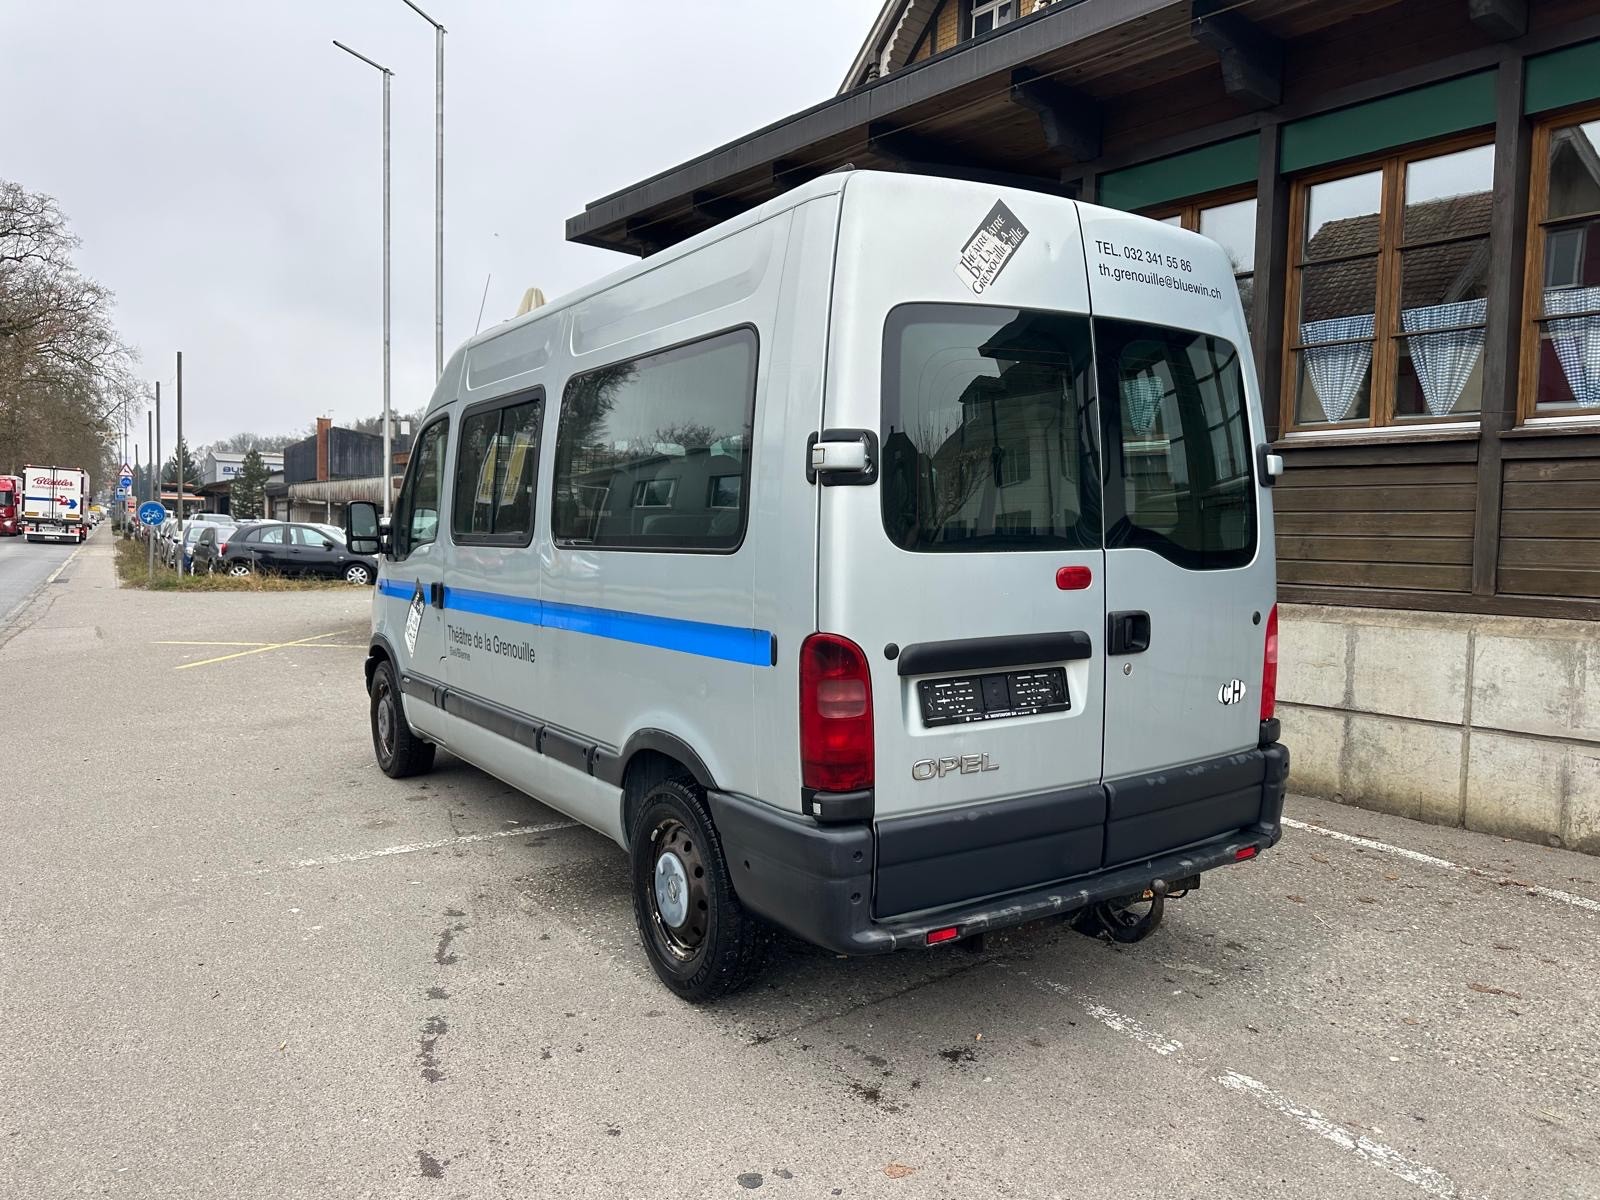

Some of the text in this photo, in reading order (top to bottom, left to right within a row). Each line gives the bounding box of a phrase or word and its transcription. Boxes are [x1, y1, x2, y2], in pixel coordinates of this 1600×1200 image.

[1095, 240, 1192, 273] TEL. 032 341 55 86
[1098, 263, 1222, 300] th.grenouille@bluewin.ch
[447, 624, 536, 663] Théâtre de la Grenouille
[1222, 679, 1241, 705] CH
[912, 752, 1000, 780] OPEL
